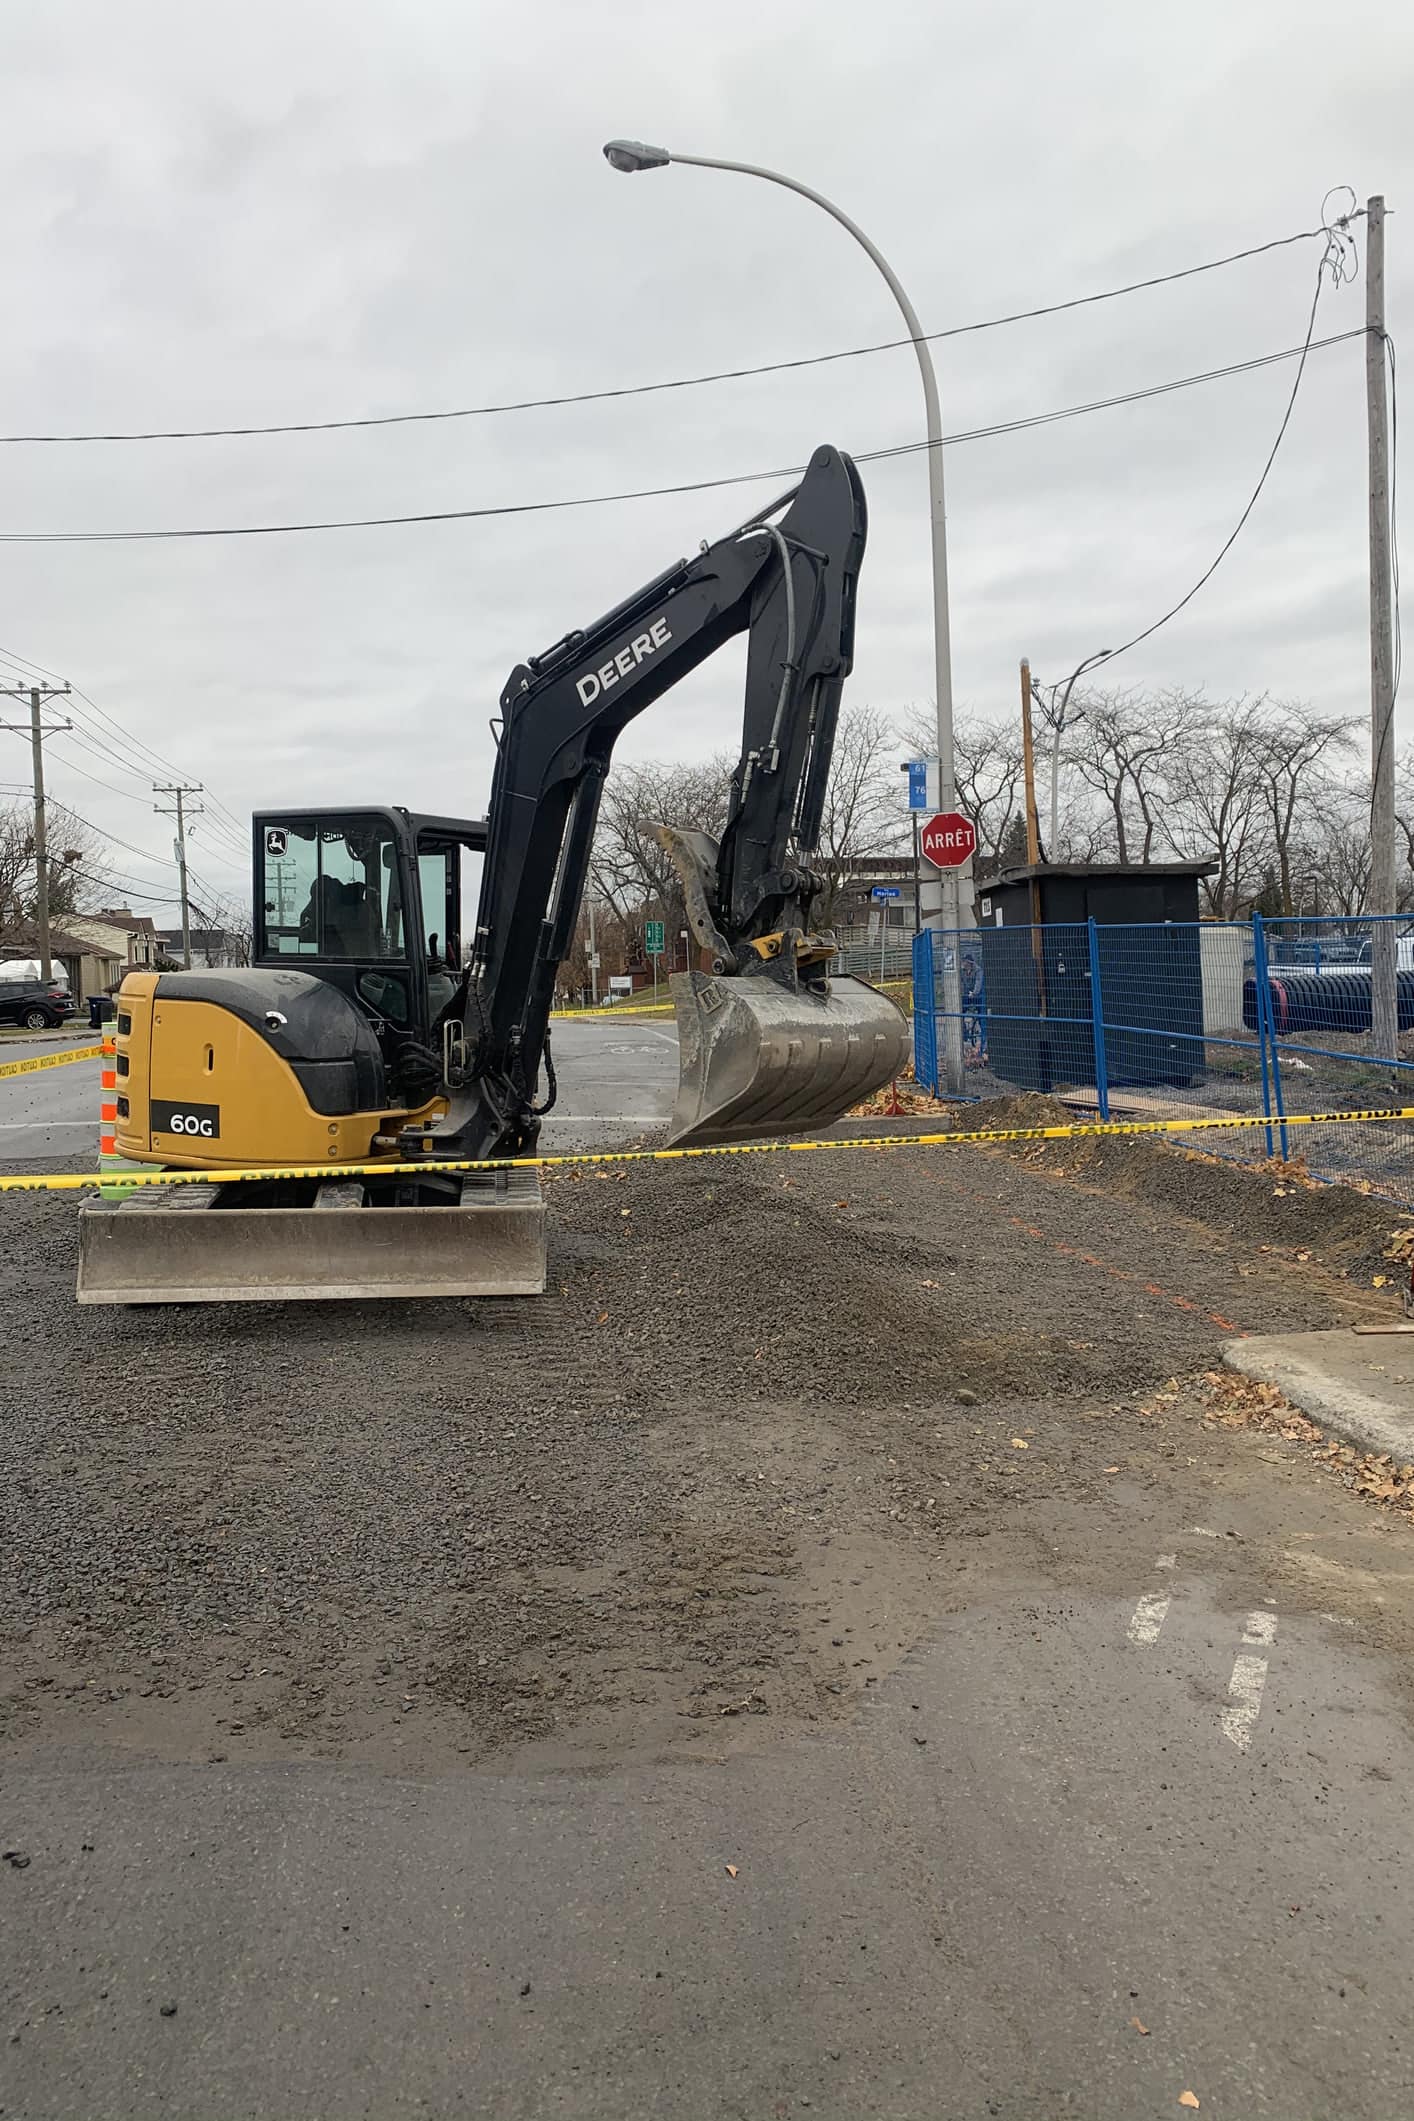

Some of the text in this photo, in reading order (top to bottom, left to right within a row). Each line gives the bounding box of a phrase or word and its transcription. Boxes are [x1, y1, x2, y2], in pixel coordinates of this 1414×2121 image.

[576, 616, 673, 707] DEERE
[925, 828, 972, 850] ARRÊT
[170, 1114, 213, 1136] 60G
